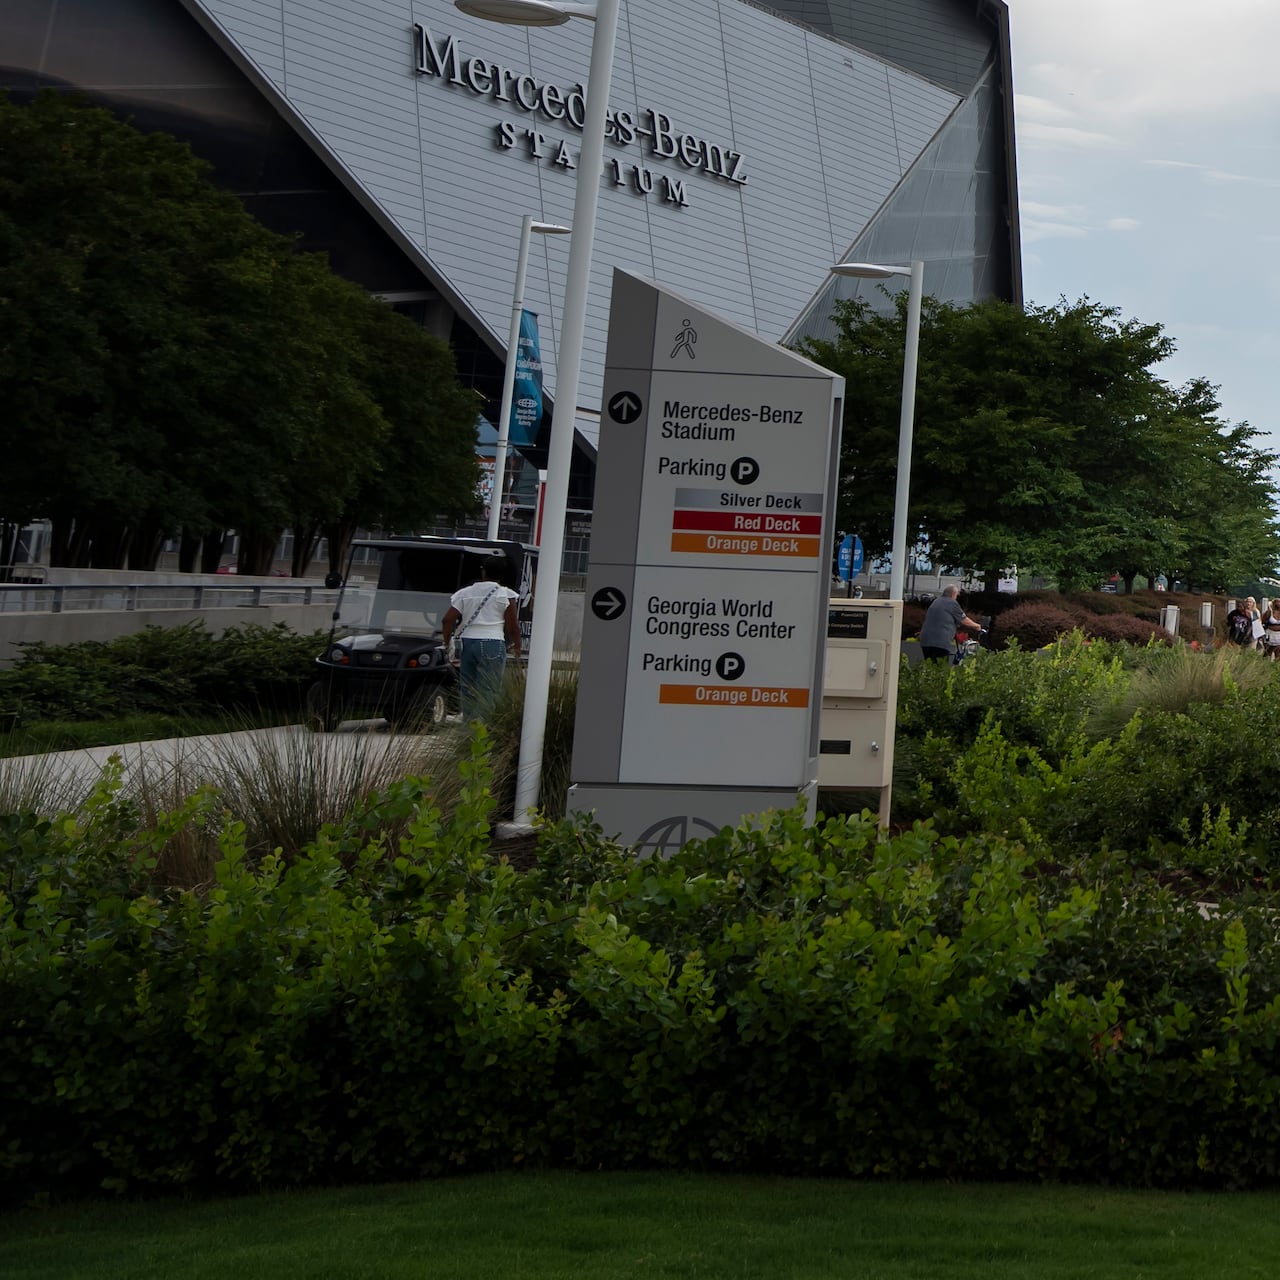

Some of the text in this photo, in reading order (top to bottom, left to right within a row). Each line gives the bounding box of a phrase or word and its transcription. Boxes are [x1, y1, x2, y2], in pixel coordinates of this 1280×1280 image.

[498, 120, 690, 207] STAIUM
[663, 401, 804, 424] Mercedes-Benz
[661, 421, 735, 441] Stadium
[658, 457, 727, 481] Parking
[720, 493, 802, 509] Silver Deck
[734, 515, 801, 531] Red Deck
[706, 535, 799, 553] Orange Deck
[647, 596, 773, 619] Georgia World
[646, 616, 796, 639] Congress Center
[643, 653, 712, 676] Parking
[695, 686, 788, 704] Orange Deck
